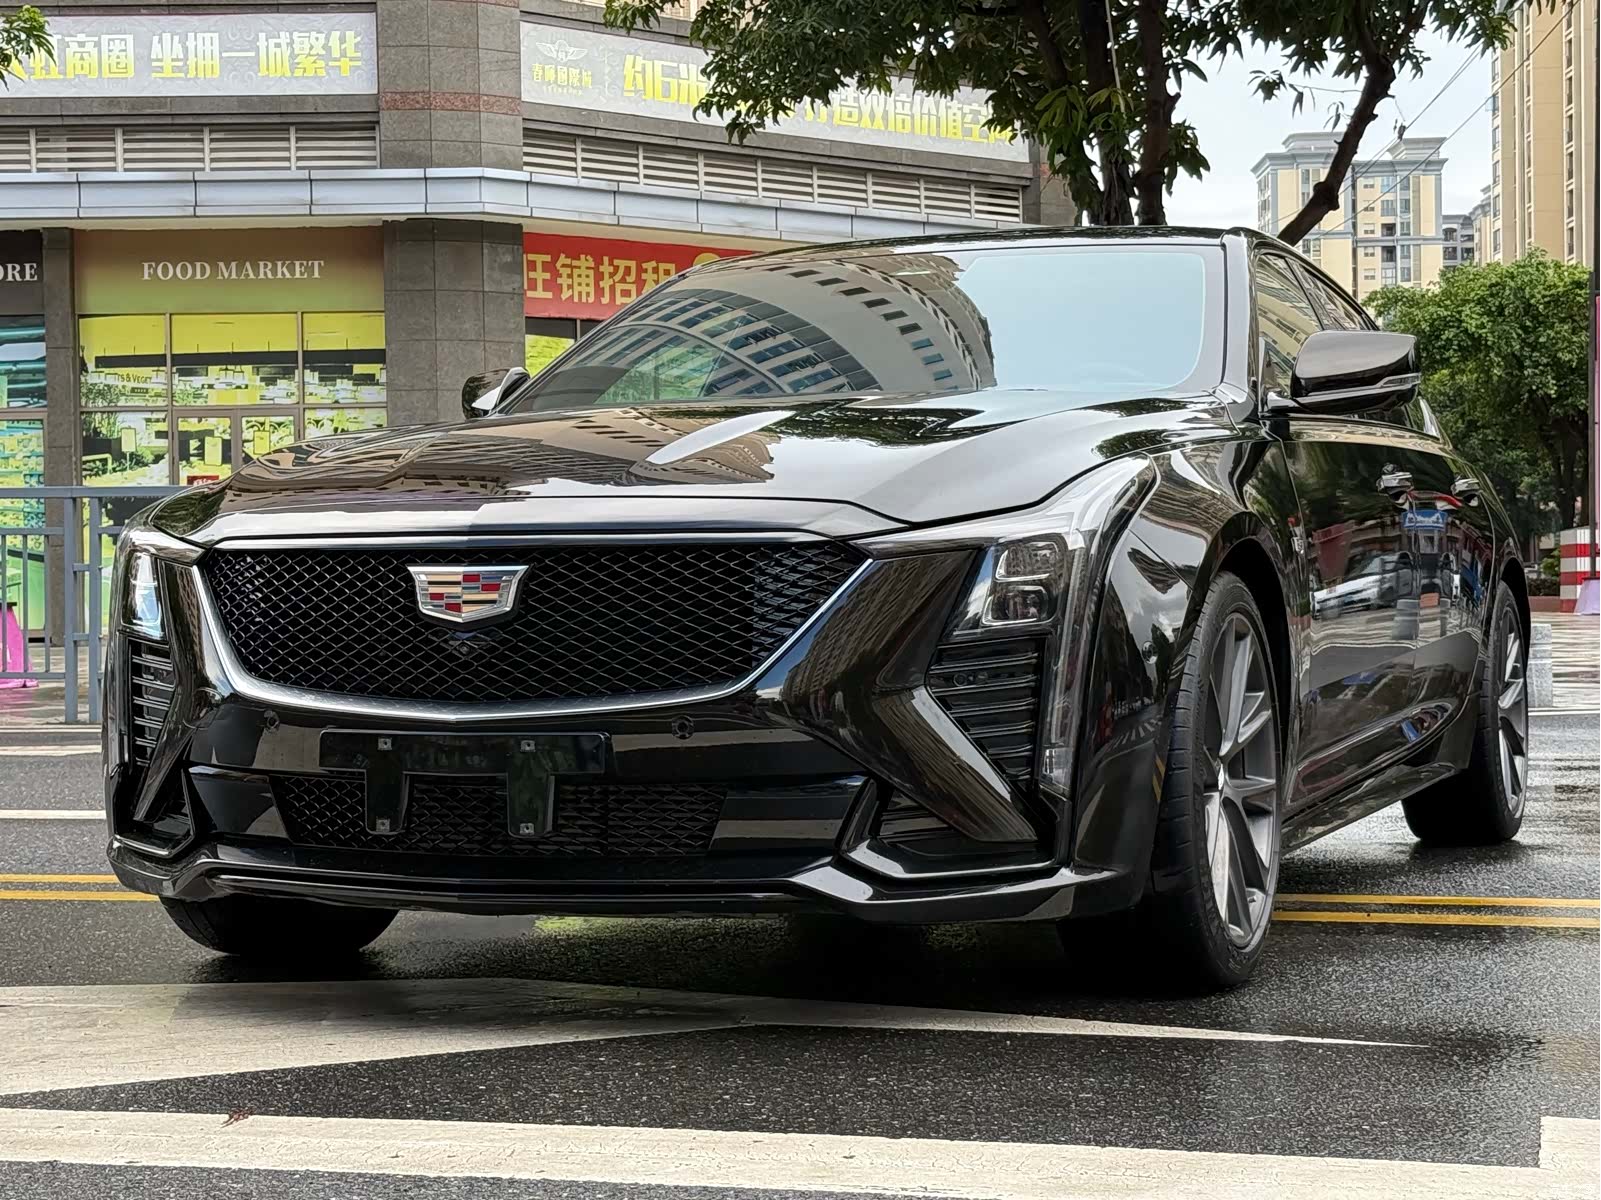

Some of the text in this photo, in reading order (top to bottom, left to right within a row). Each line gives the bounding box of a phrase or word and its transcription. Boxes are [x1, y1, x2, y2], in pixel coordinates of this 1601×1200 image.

[1, 31, 362, 79] 虹商圈 坐拥一城繁华
[0, 262, 38, 282] RE
[141, 260, 325, 281] FOOD MARKET
